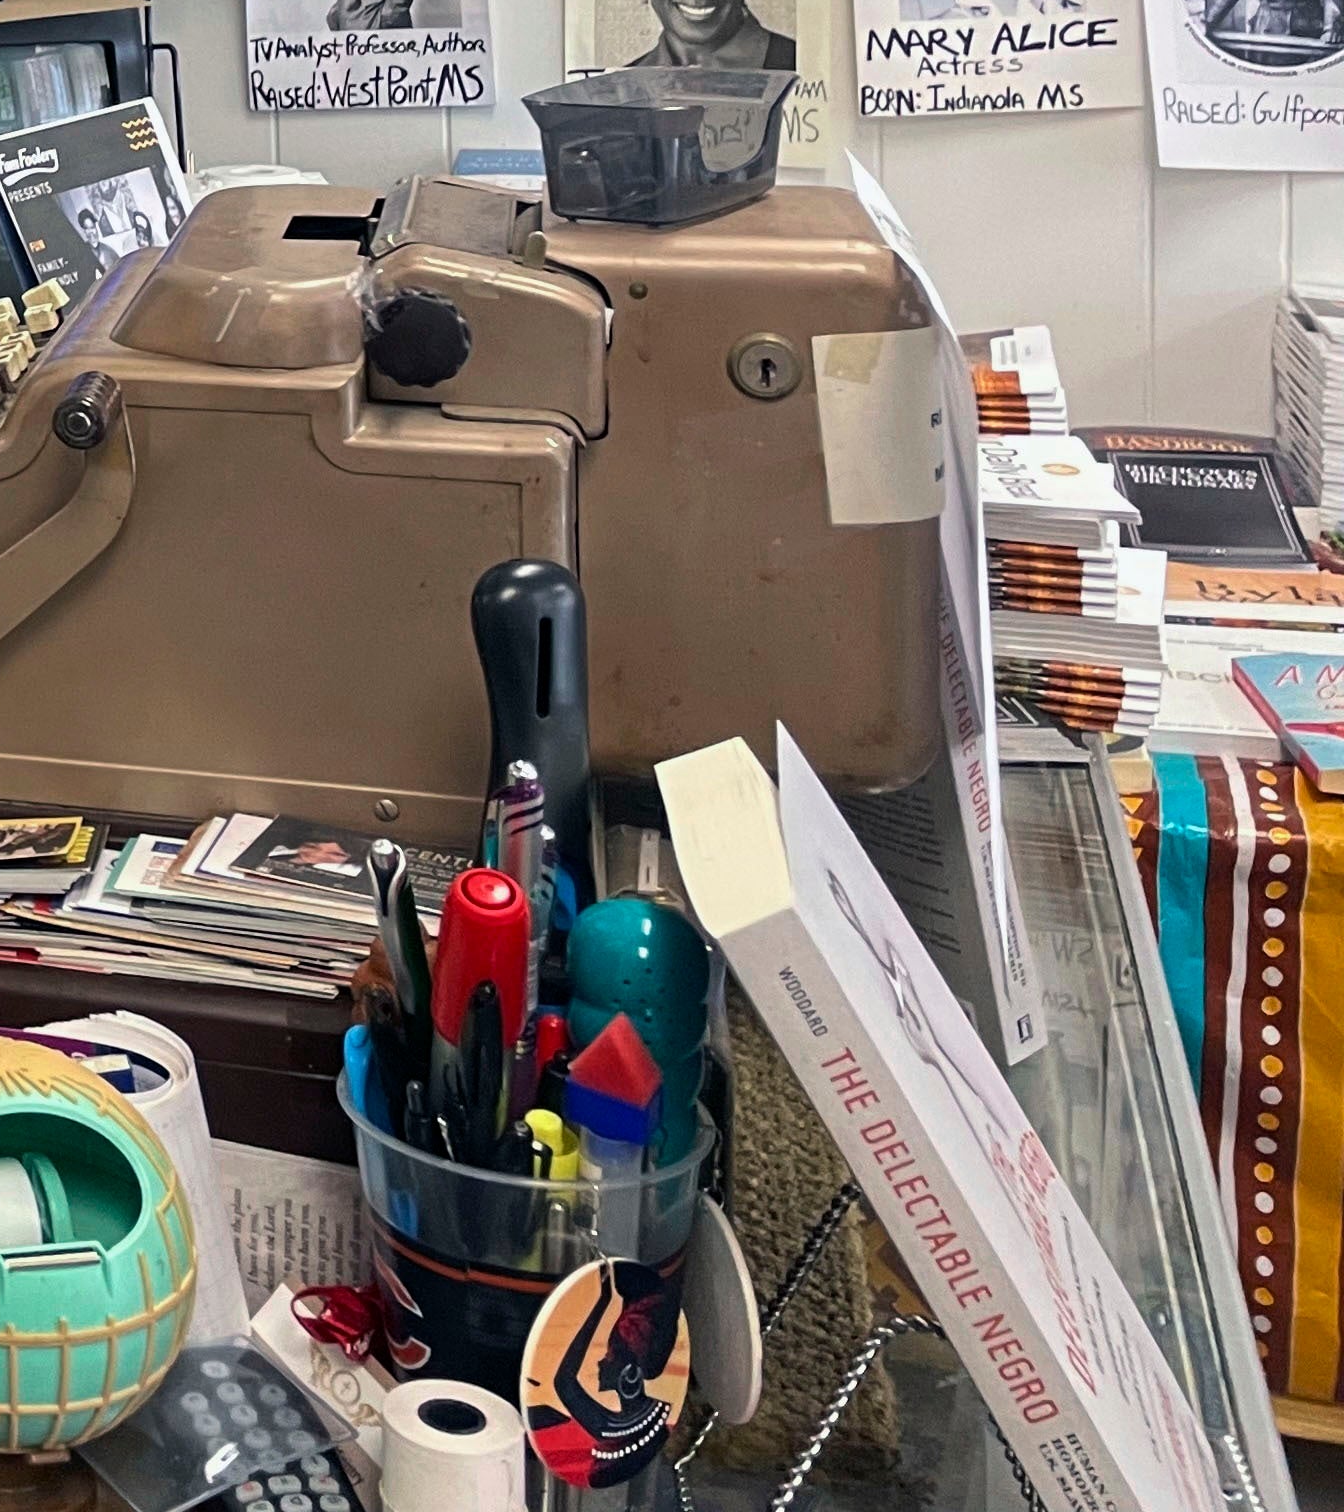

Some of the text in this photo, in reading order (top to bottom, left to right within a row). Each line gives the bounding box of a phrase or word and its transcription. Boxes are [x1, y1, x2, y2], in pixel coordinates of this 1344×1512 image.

[250, 37, 273, 63] TV
[866, 19, 1119, 62] MARY ALICE
[435, 63, 484, 106] MS
[1037, 84, 1083, 109] MS
[8, 181, 53, 203] PRESENTS
[777, 965, 830, 1038] WOODARD
[818, 1046, 1061, 1427] THE DELECTABLE NEGRO
